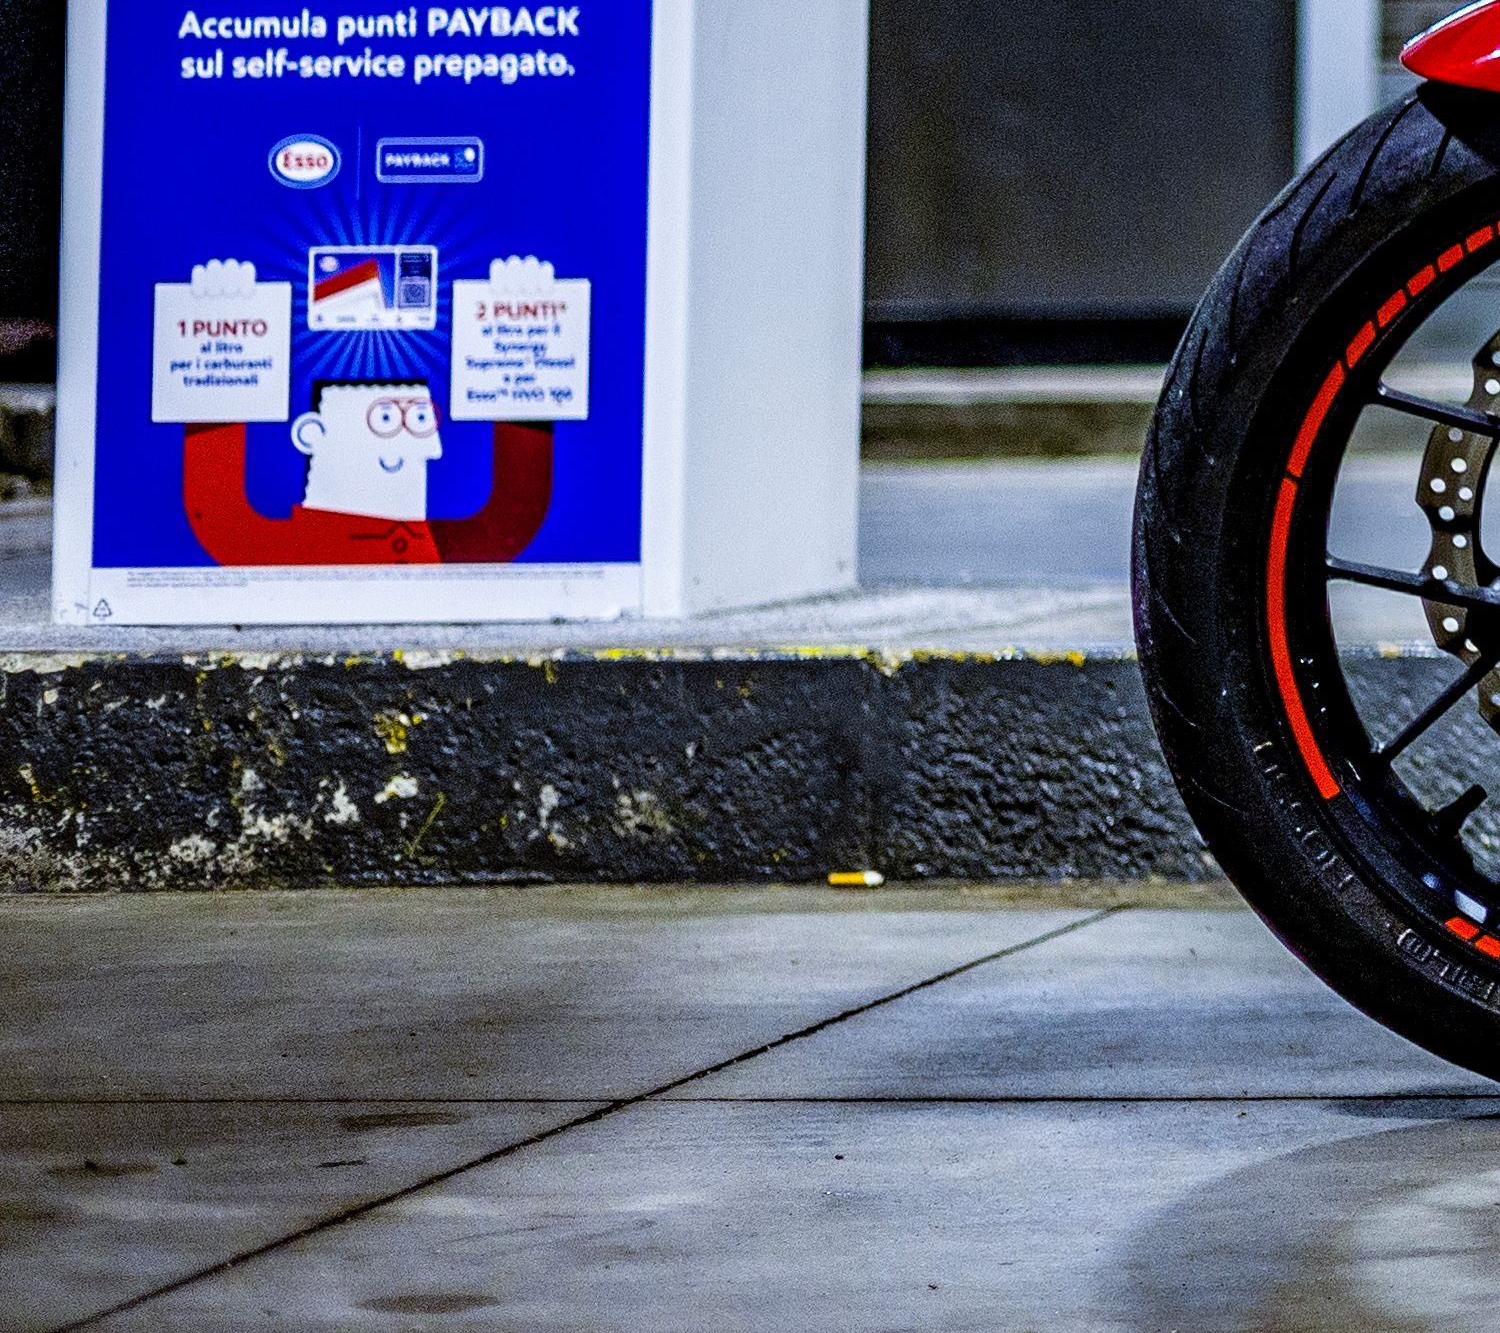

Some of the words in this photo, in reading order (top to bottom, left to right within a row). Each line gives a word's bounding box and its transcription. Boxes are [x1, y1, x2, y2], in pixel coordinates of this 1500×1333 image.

[178, 10, 328, 39] Accumula
[337, 7, 418, 45] punti
[426, 6, 581, 38] PAYBACK
[180, 48, 224, 79] sul
[231, 47, 405, 79] self-service
[414, 49, 577, 85] prepagato.
[281, 148, 329, 170] Esso
[384, 152, 451, 169] PAYBACK
[178, 318, 187, 338] 1
[192, 318, 268, 338] PUNTO
[203, 356, 273, 370] carburanti
